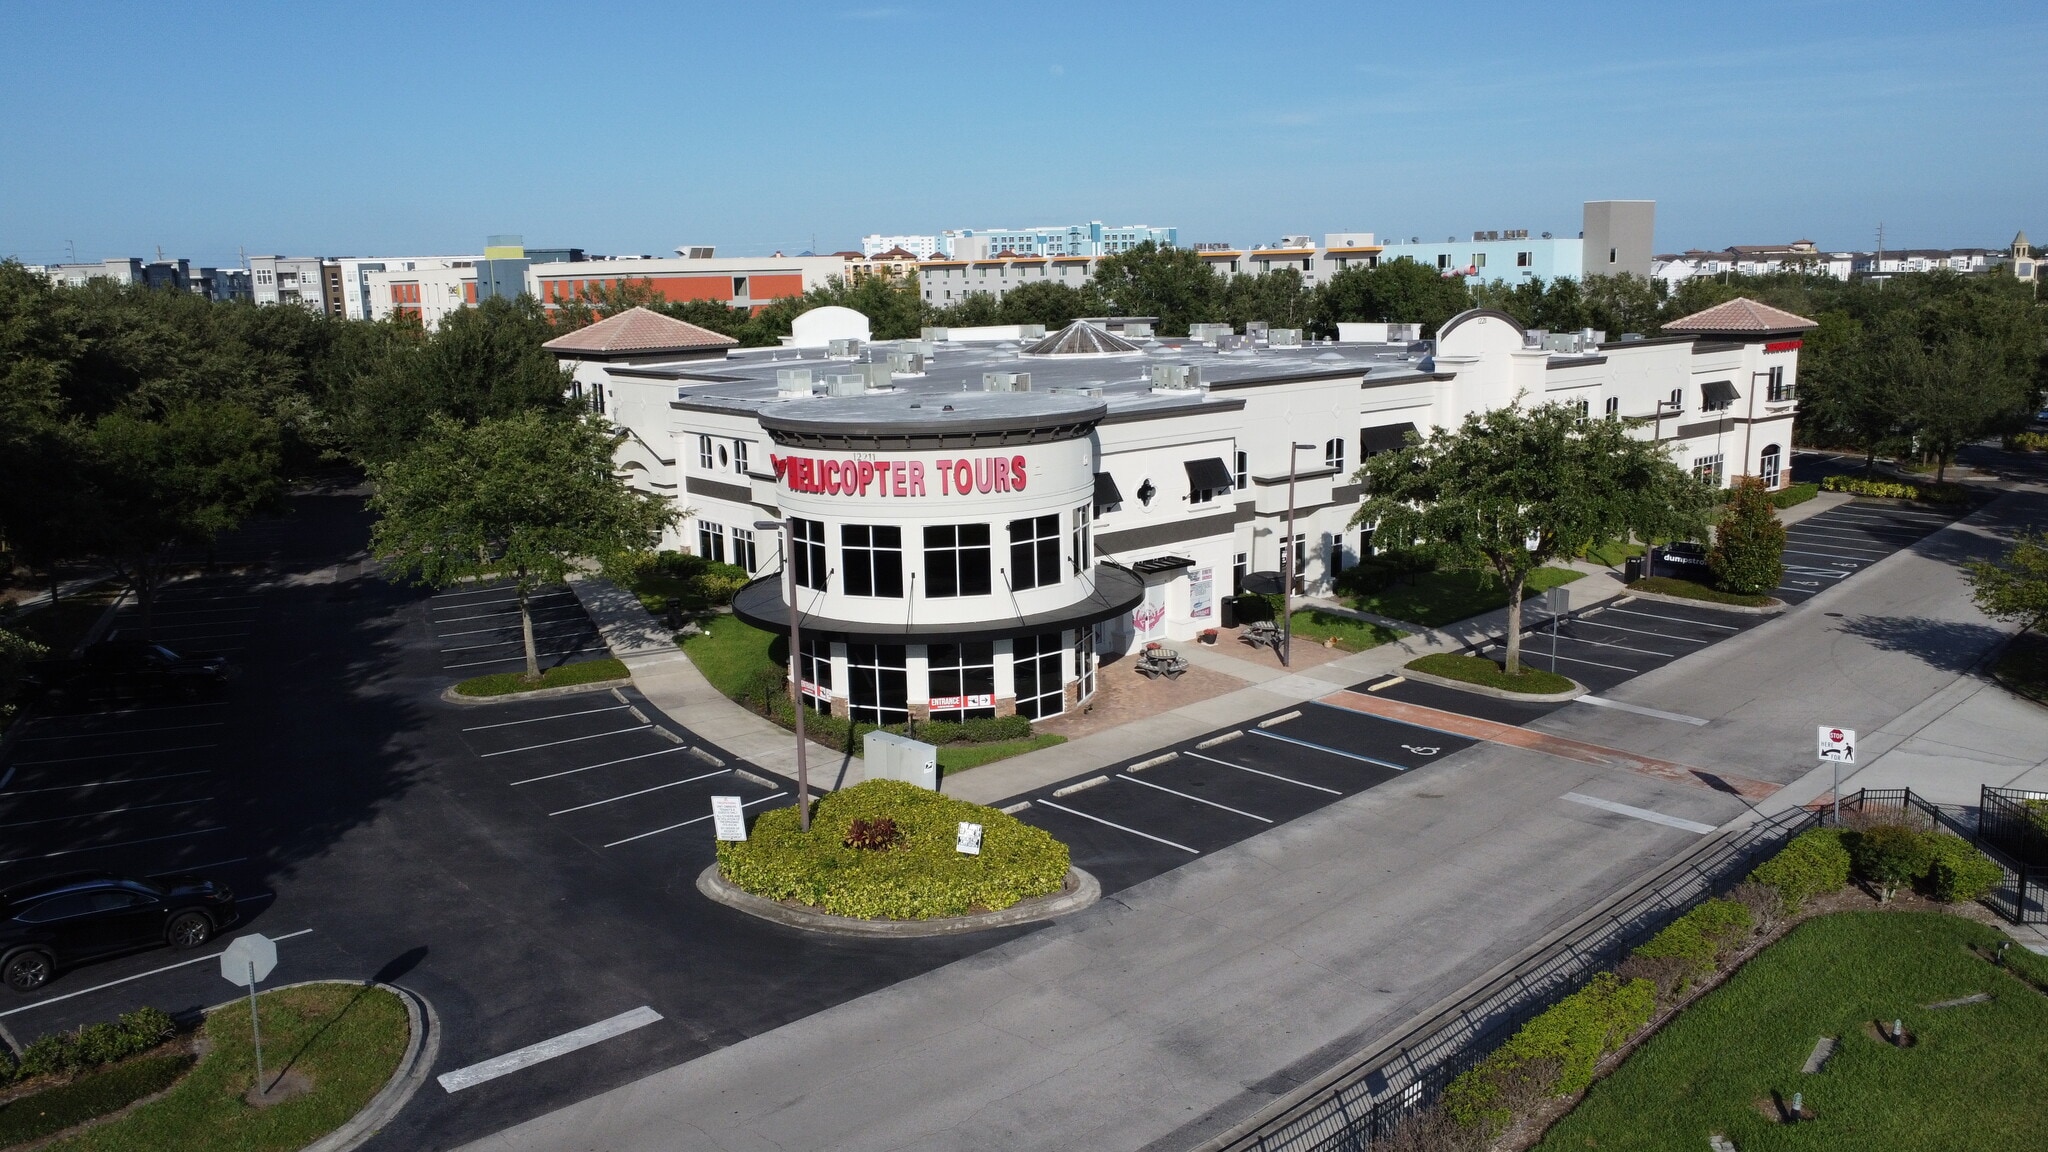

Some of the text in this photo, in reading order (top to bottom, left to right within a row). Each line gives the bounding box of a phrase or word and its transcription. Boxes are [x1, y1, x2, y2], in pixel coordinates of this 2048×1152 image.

[787, 455, 1027, 497] HELICOPTER TOURS
[931, 697, 960, 706] ENTRANCE
